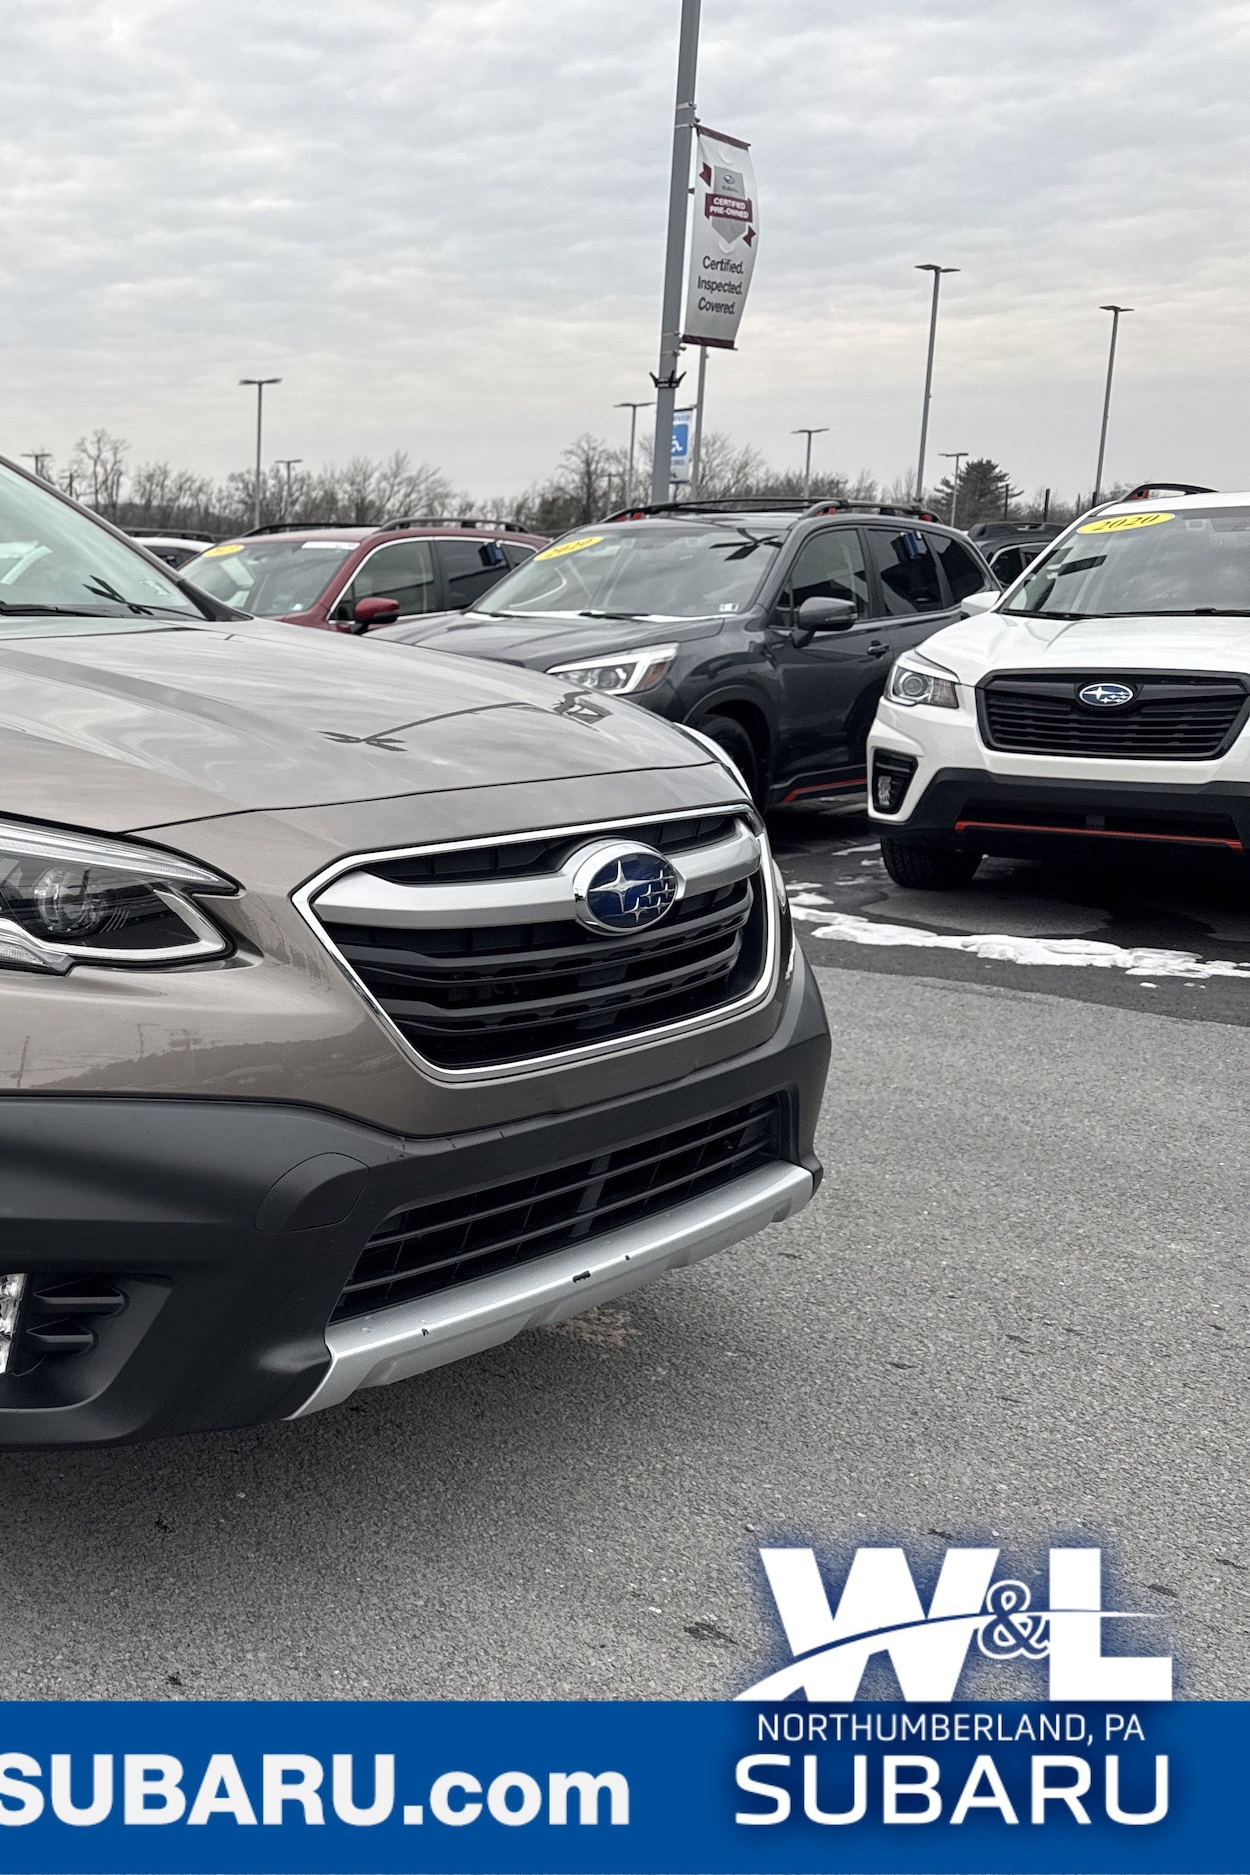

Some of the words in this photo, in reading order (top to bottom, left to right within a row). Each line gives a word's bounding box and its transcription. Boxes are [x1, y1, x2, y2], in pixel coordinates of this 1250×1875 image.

[710, 205, 749, 219] PRE-OWNED
[713, 197, 746, 210] CERTIFIED
[703, 255, 744, 275] Certified.
[697, 275, 743, 295] Inspected.
[698, 296, 736, 315] Covered.
[1092, 514, 1160, 532] 2020
